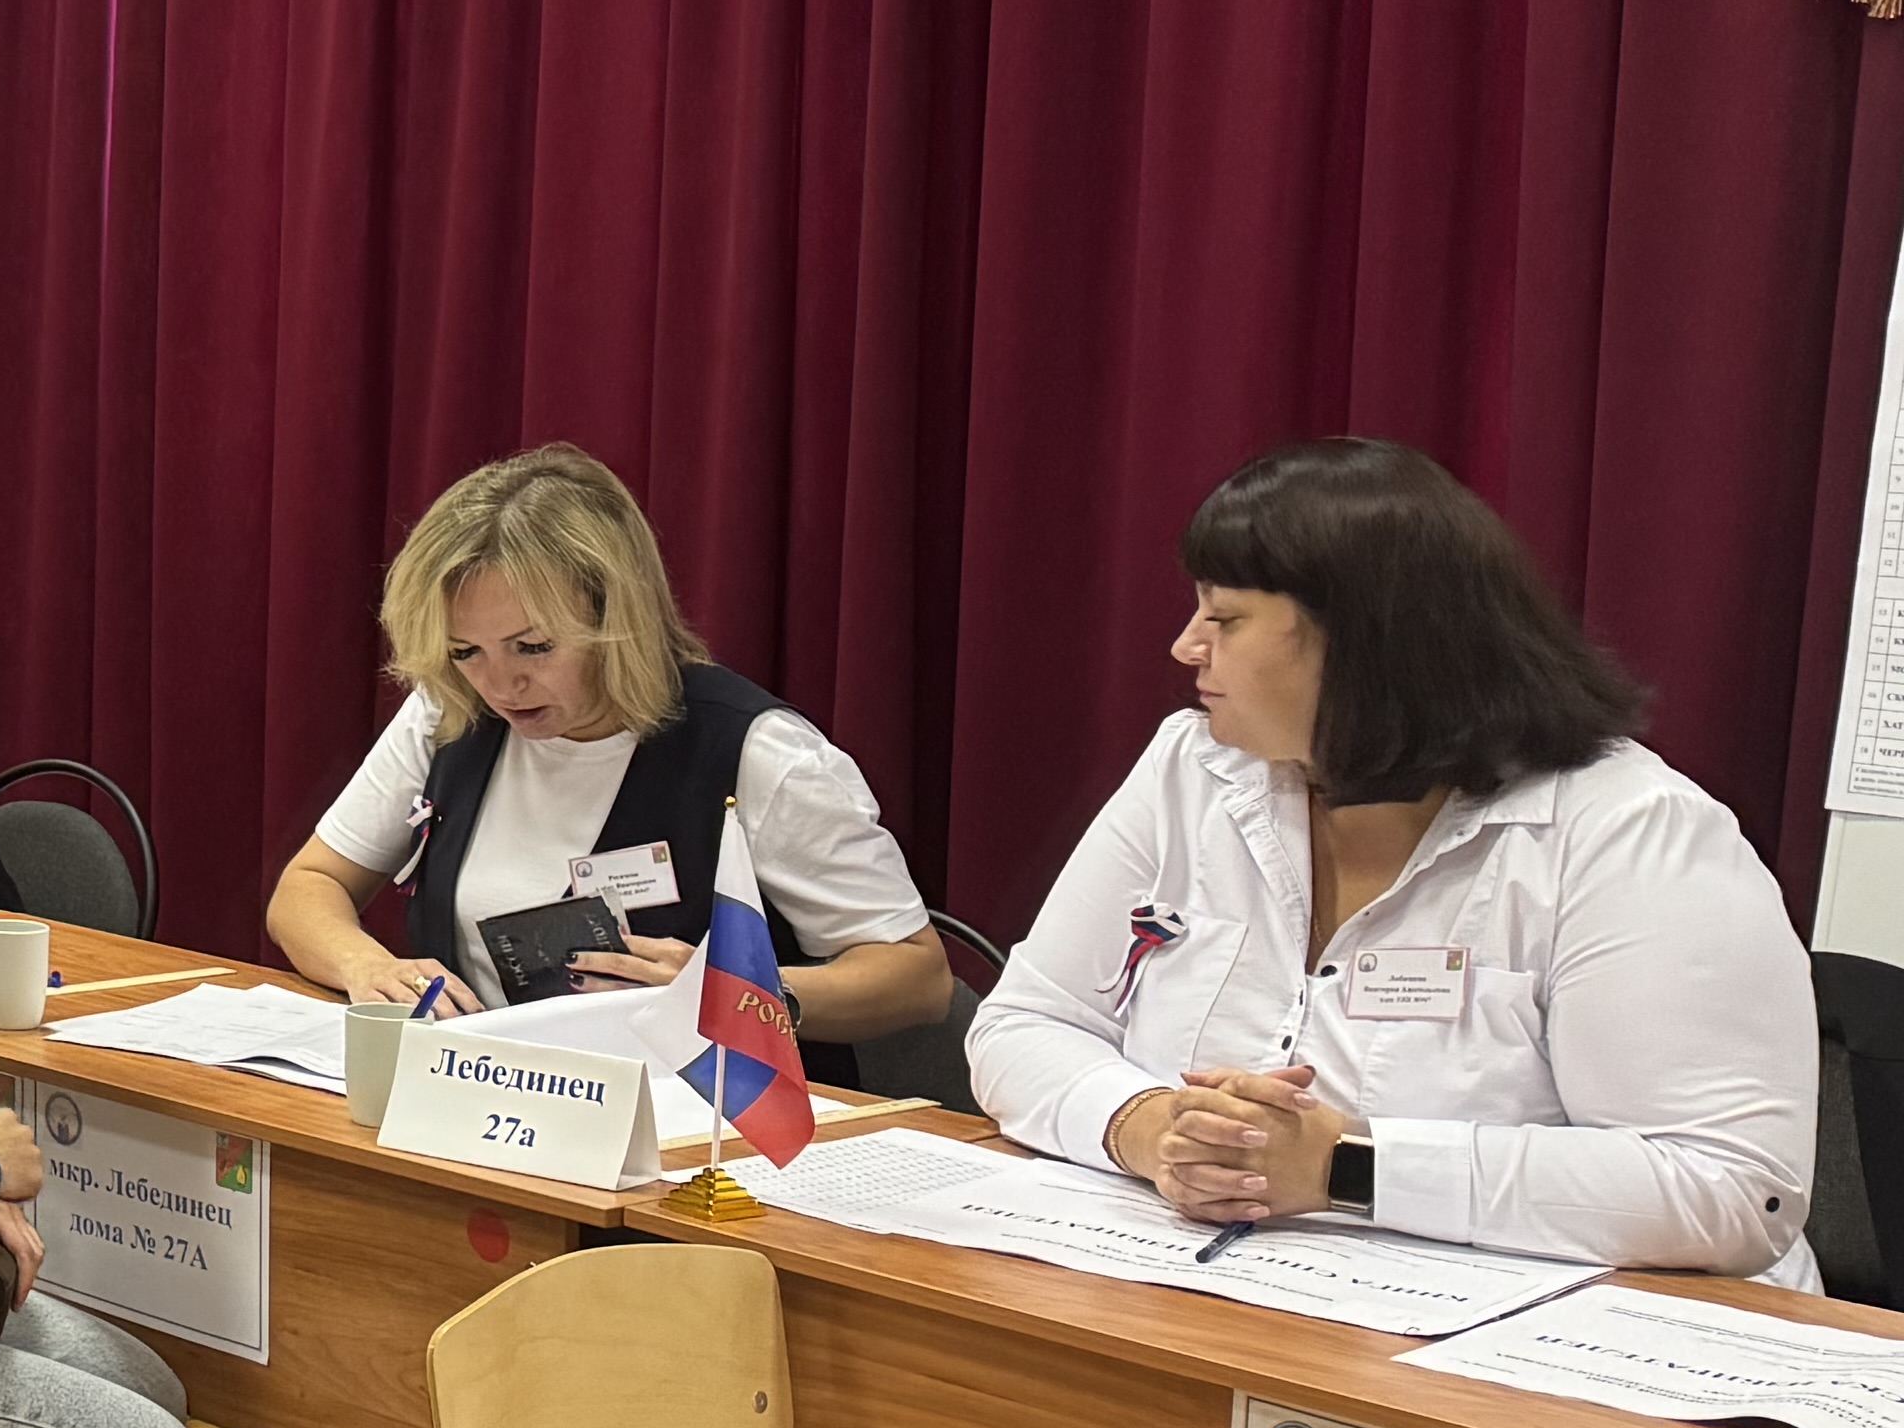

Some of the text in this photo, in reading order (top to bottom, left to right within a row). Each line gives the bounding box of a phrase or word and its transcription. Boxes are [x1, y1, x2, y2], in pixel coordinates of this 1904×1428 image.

[736, 990, 791, 1035] РОС
[430, 1048, 606, 1107] Лебединец
[481, 1113, 537, 1148] 27а
[48, 1157, 233, 1230] мкр. Лебединец
[69, 1213, 208, 1271] дома № 27А
